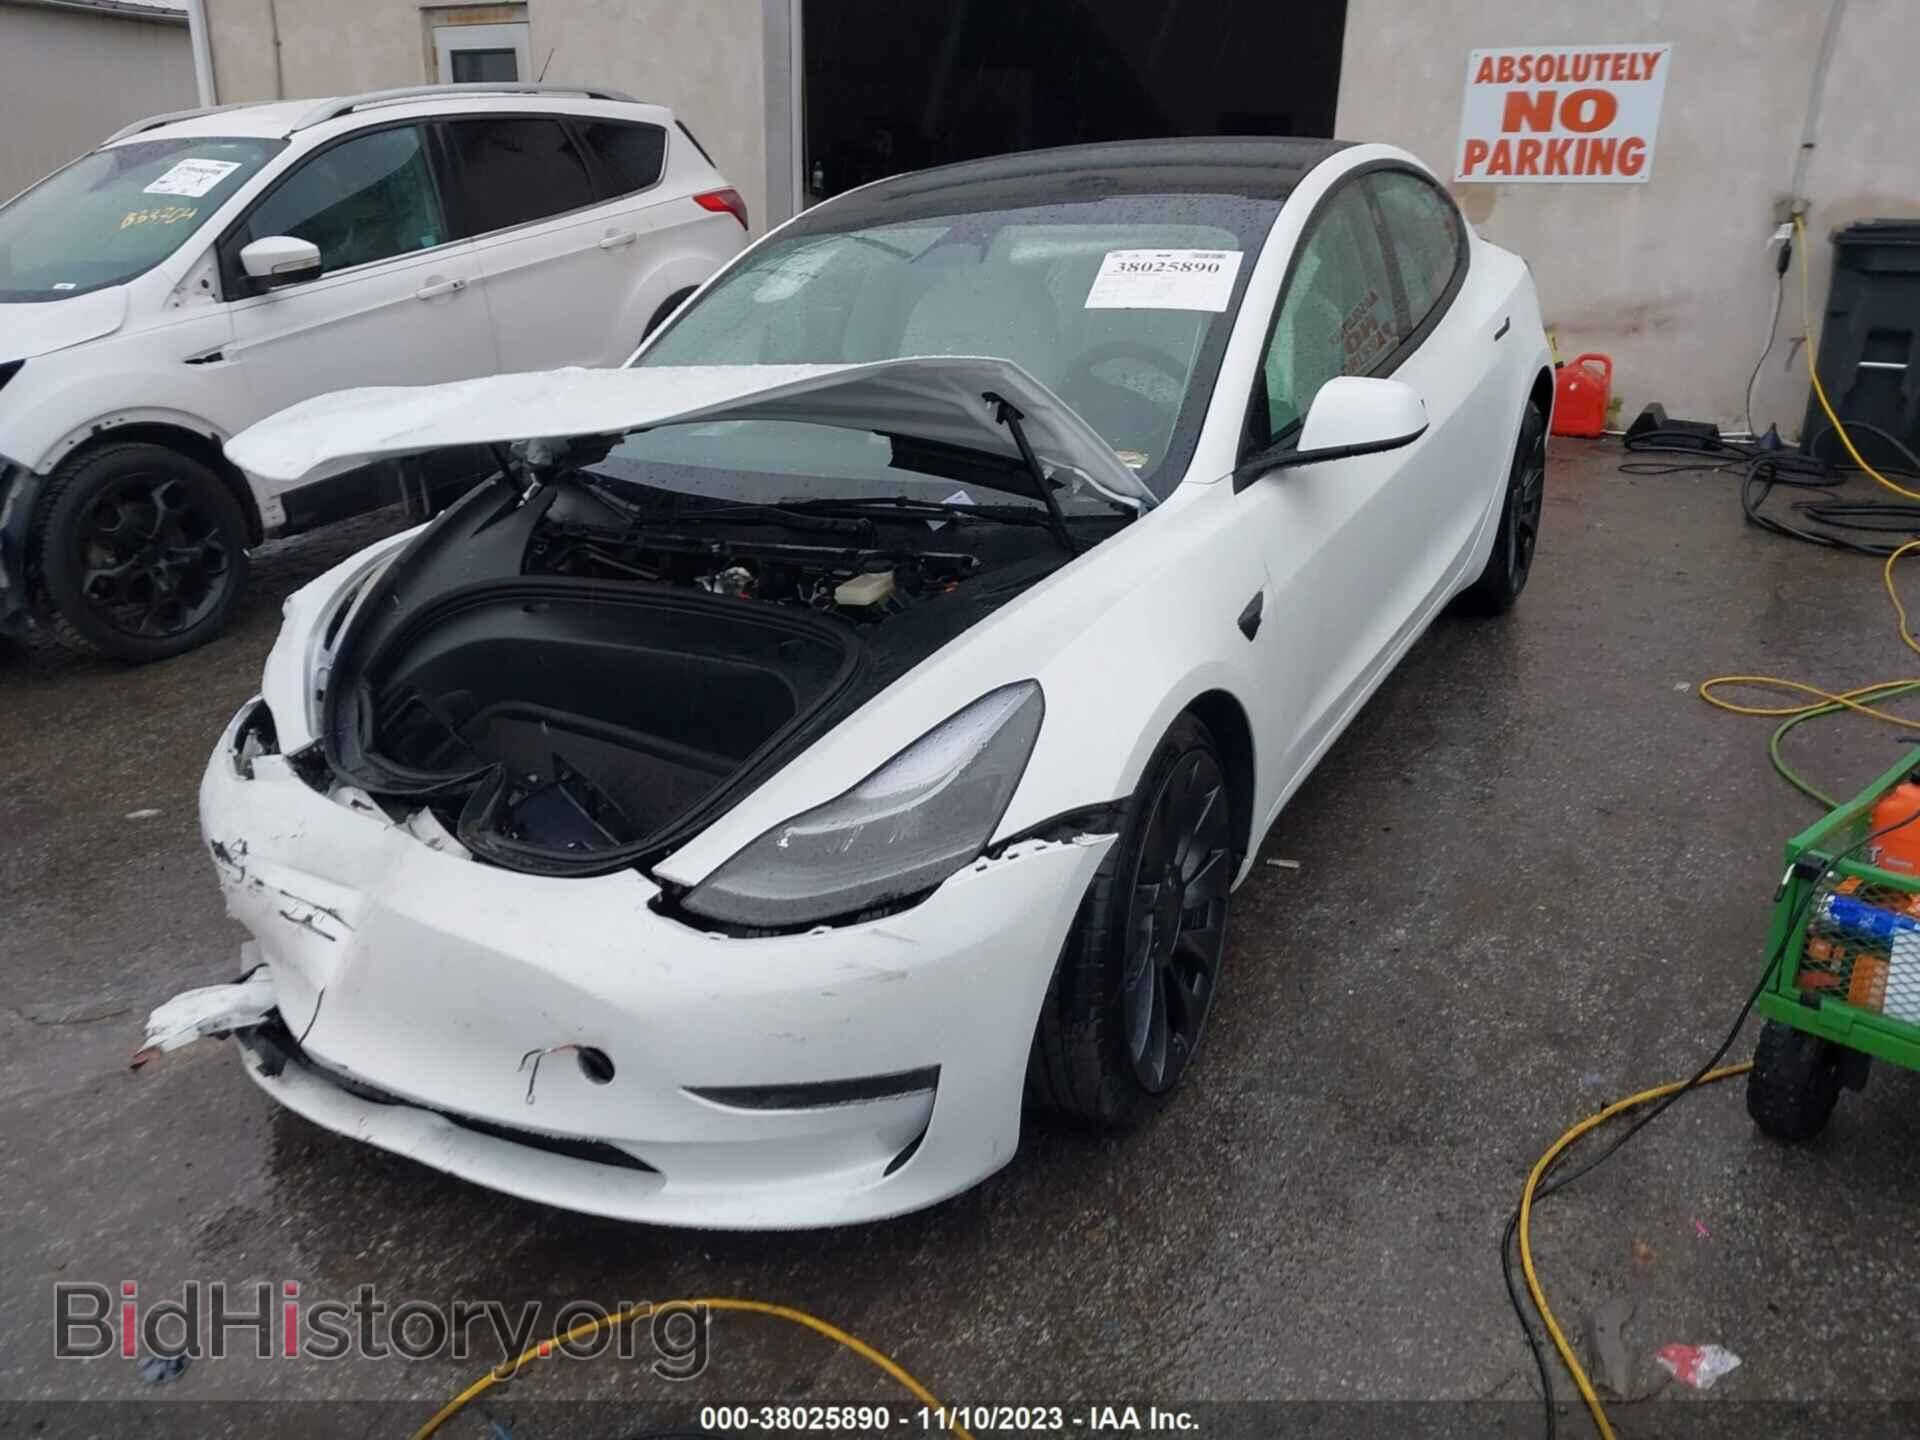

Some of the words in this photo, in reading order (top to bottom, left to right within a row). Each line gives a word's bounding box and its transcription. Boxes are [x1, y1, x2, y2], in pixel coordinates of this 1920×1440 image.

[1473, 51, 1662, 84] ABSOLUTELY
[1501, 88, 1619, 133] NO
[1462, 136, 1647, 176] PARKING
[1112, 261, 1221, 273] 38025890
